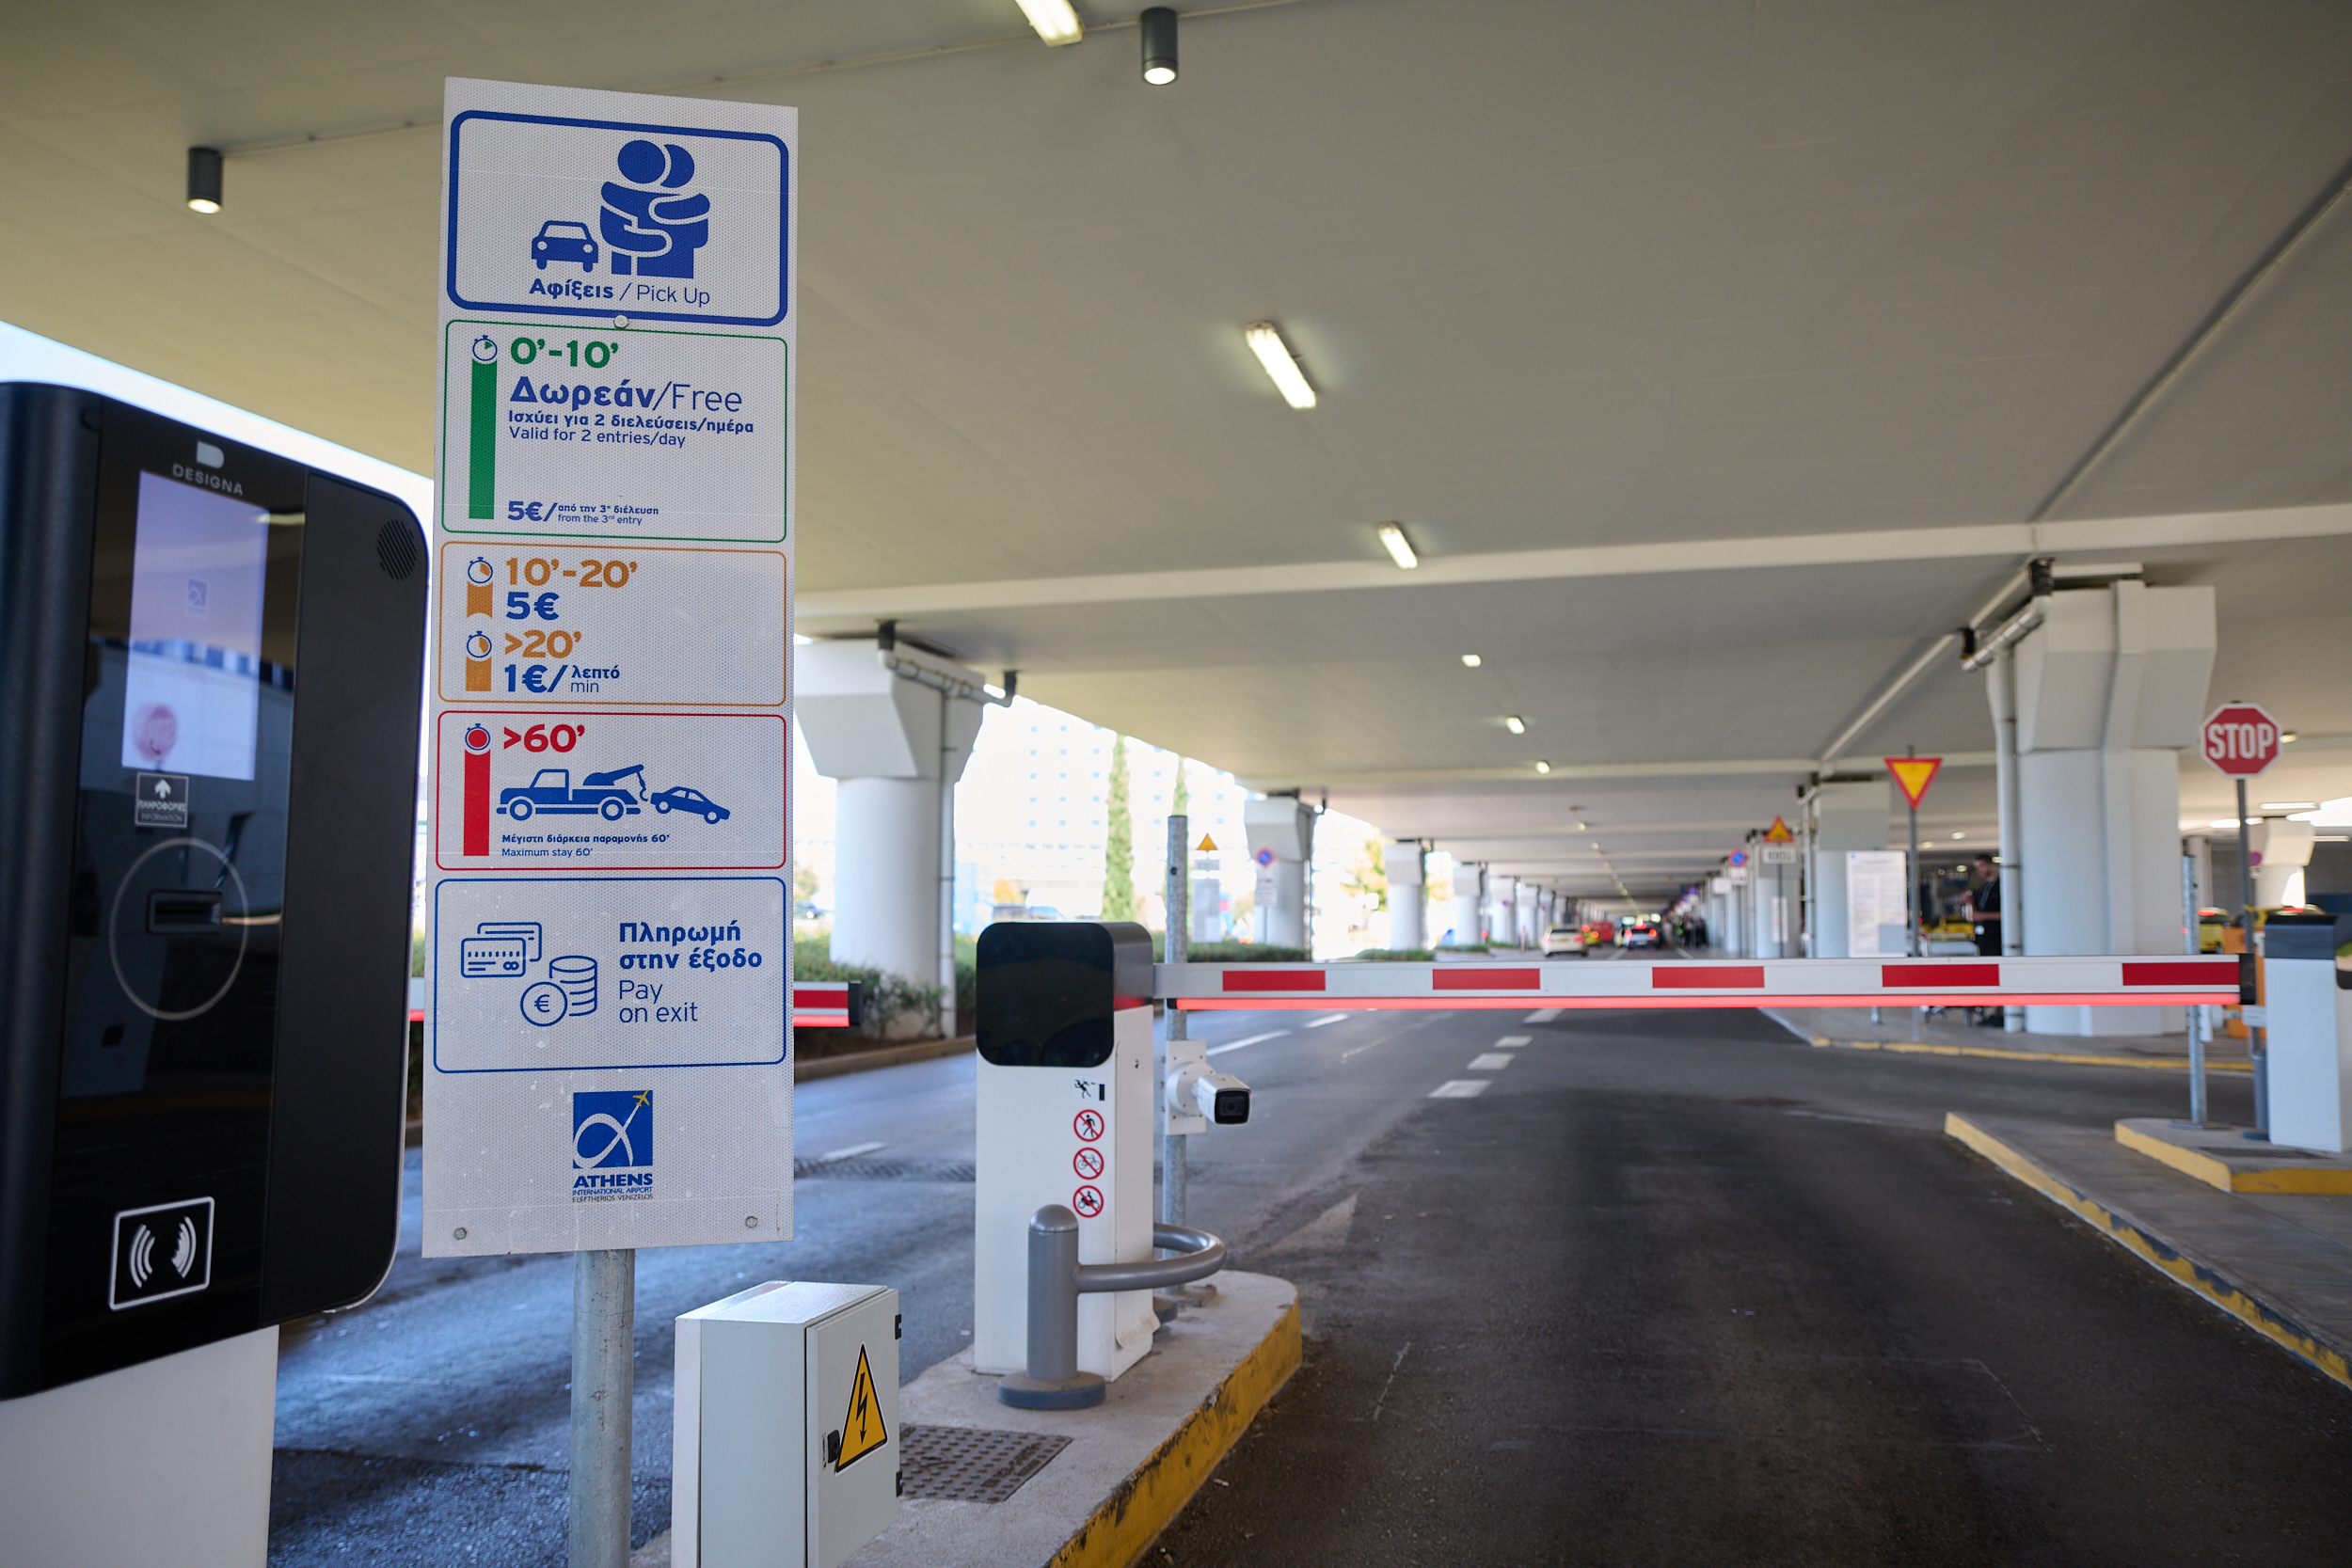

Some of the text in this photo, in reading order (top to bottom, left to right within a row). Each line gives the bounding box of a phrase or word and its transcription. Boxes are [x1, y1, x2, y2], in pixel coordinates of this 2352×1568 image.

[529, 278, 613, 300] Αφίξεις
[637, 284, 676, 302] Pick
[684, 287, 711, 307] Up
[509, 376, 743, 412] Δωρεάν/Free
[509, 410, 559, 425] Ισχύει
[564, 410, 588, 427] για
[595, 414, 605, 426] 2
[509, 426, 686, 449] Valid for 2 entries/day
[172, 463, 243, 496] DESIGNA
[558, 503, 577, 513] από
[613, 505, 659, 515] διέλευση
[558, 514, 580, 522] from
[583, 515, 598, 523] the
[617, 516, 642, 525] entry
[506, 592, 559, 620] 5€
[505, 630, 581, 658] >20'
[572, 665, 620, 679] λεπτό
[571, 680, 599, 692] min
[503, 724, 585, 752] >60'
[2207, 722, 2275, 760] STOP
[502, 834, 543, 844] Μέγιστη
[547, 834, 590, 844] διάρκεια
[552, 848, 573, 858] stay
[620, 920, 741, 947] Πληρωμή
[620, 948, 762, 973] στην έξοδο
[619, 980, 663, 1004] Pay
[619, 1002, 698, 1022] on exit
[572, 1173, 654, 1188] ATHENS
[572, 1187, 625, 1196] INTERNATIONAL
